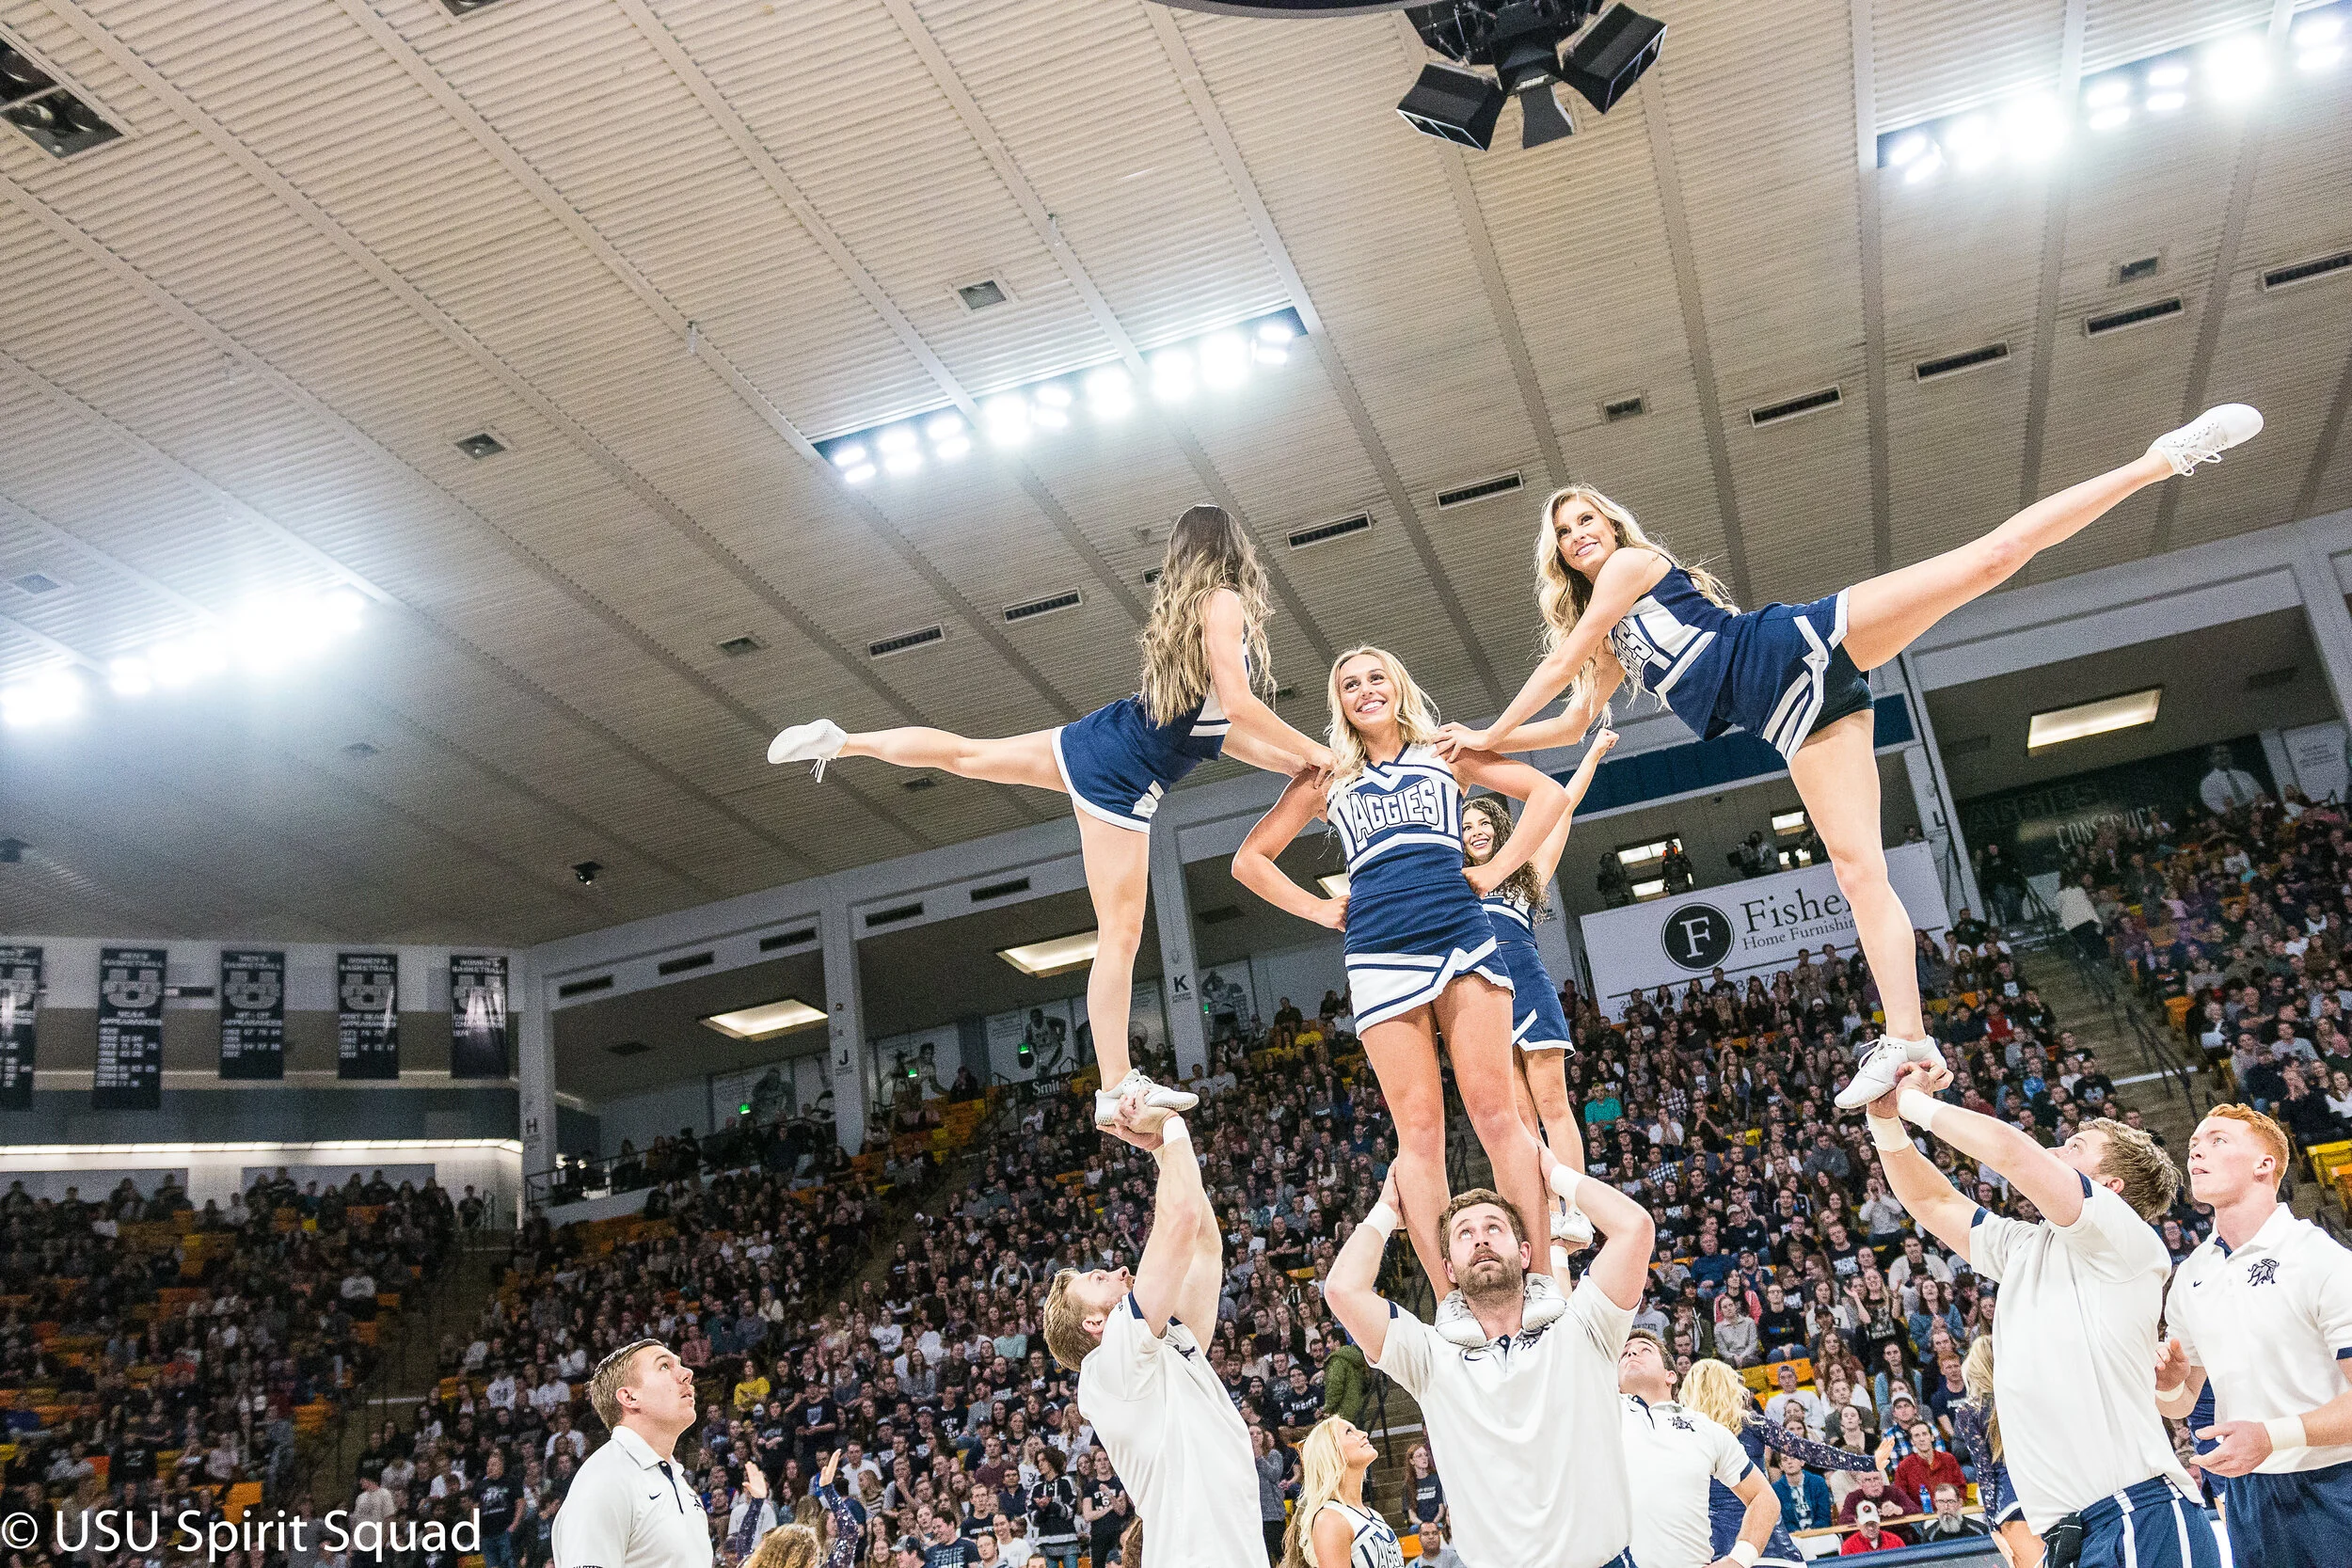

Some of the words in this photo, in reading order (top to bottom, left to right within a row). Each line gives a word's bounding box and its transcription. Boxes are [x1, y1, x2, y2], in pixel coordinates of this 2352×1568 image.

[1350, 778, 1439, 843] AGGIES
[1679, 916, 1710, 958] F
[1742, 935, 1787, 951] Home
[1173, 974, 1189, 992] K
[838, 1049, 849, 1066] J
[526, 1118, 537, 1134] H
[1102, 1496, 1110, 1506] 6
